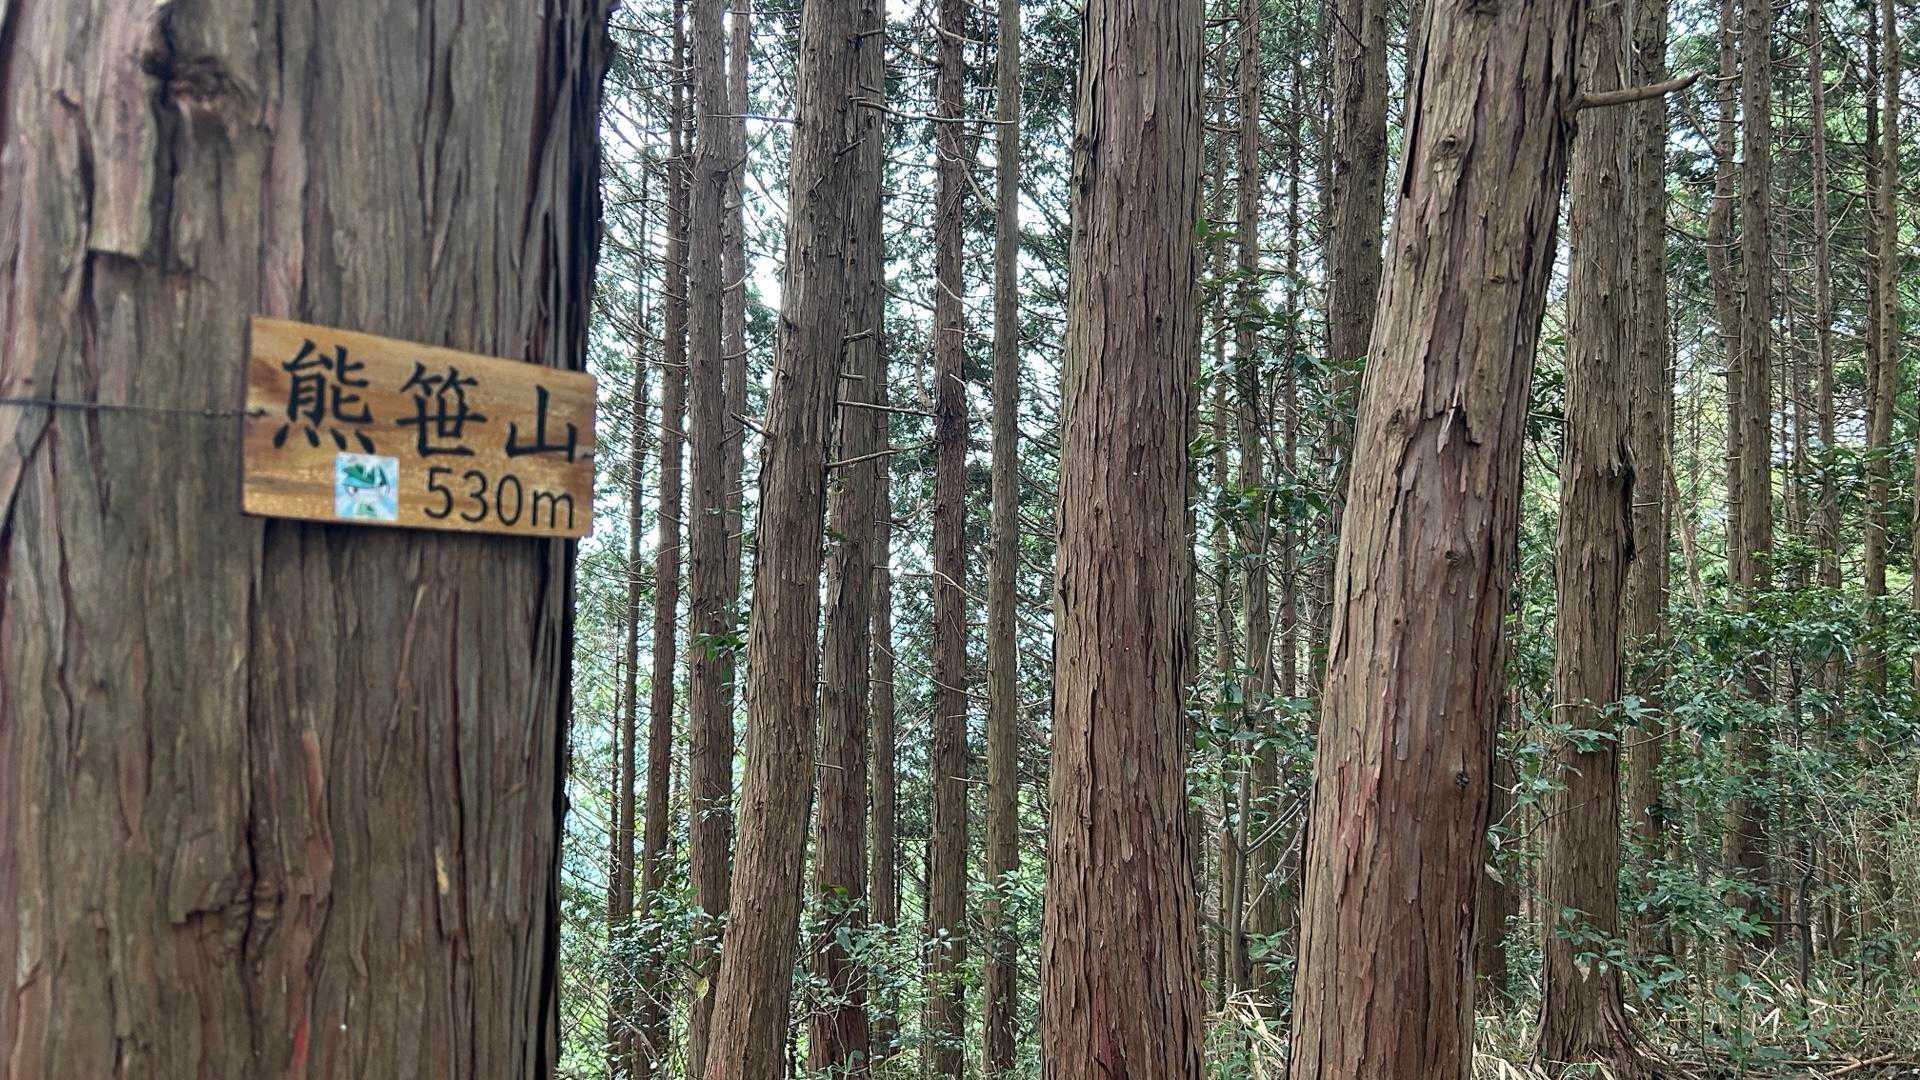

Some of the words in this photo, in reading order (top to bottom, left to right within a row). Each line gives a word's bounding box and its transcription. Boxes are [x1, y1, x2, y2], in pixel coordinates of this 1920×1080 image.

[273, 338, 578, 463] 熊笹山
[424, 466, 575, 529] 530m
